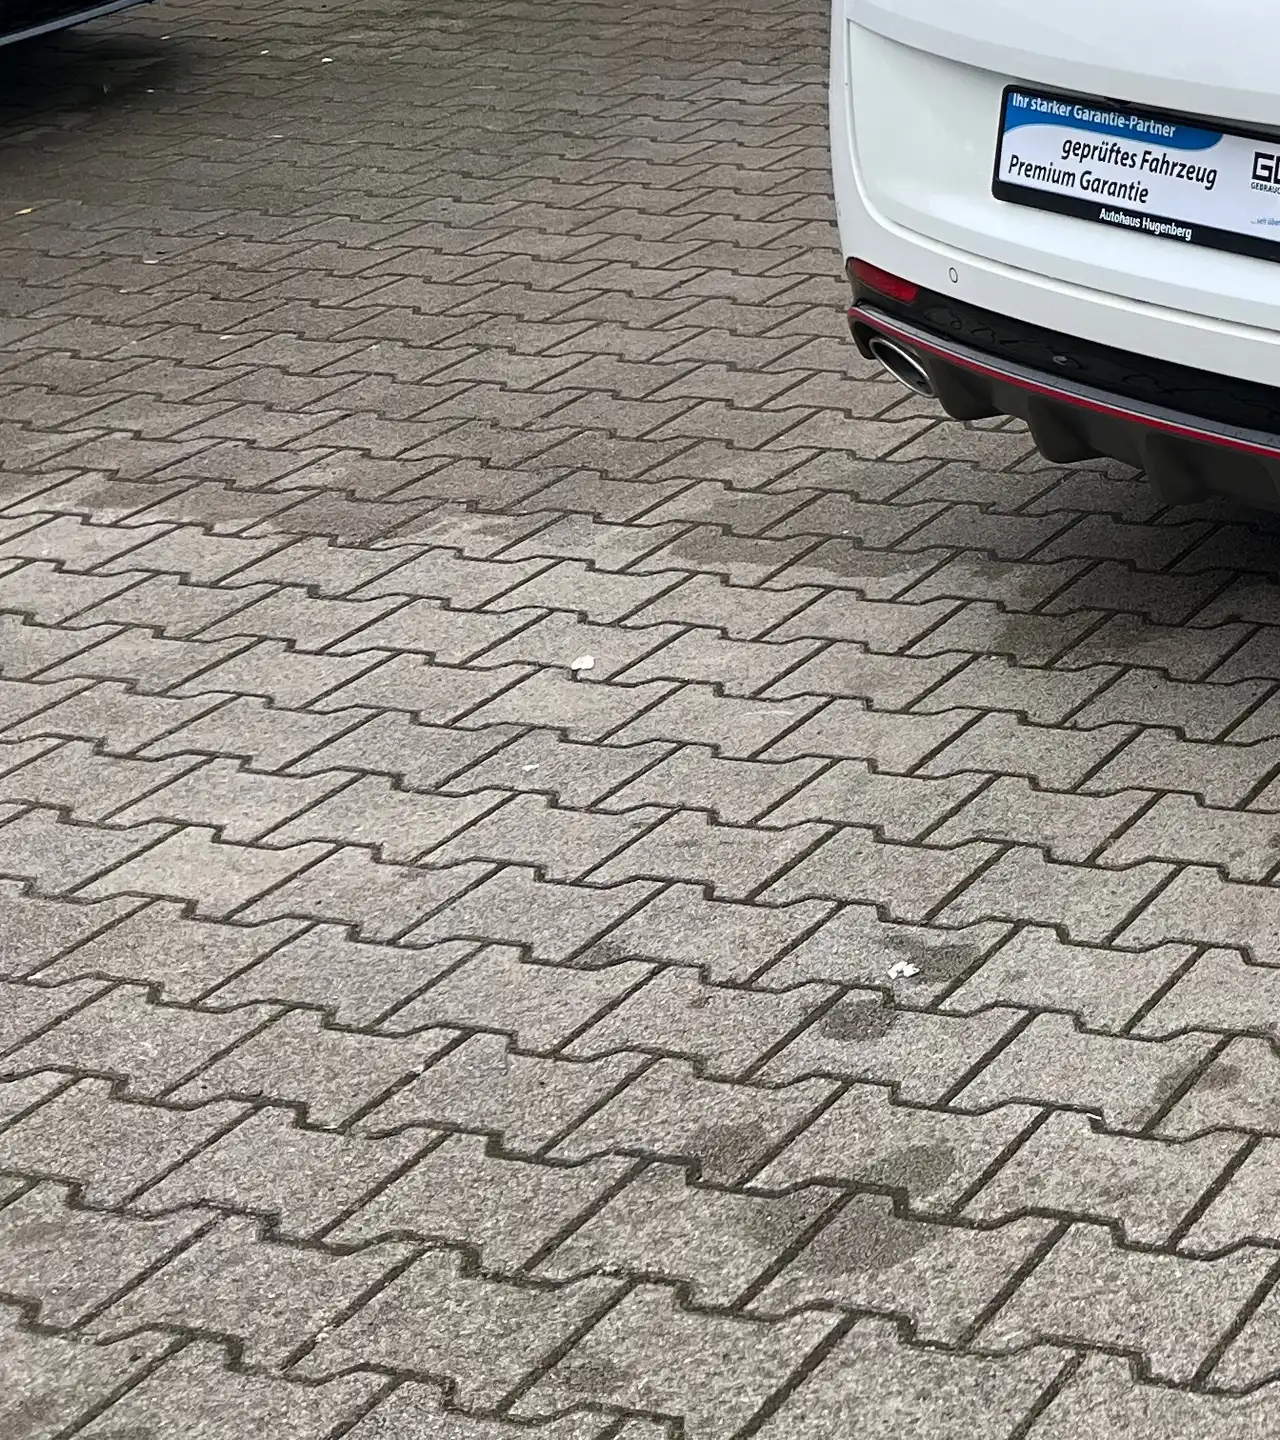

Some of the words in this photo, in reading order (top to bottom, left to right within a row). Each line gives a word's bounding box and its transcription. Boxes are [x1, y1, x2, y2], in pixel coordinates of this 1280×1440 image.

[1012, 93, 1028, 109] Ihr
[1030, 100, 1072, 117] starker
[1073, 108, 1177, 139] Garantie-Partner
[1008, 154, 1076, 188] Premium
[1080, 170, 1149, 203] Garantie
[1062, 138, 1137, 169] geprüftes
[1141, 151, 1218, 191] Fahrzeug
[1099, 208, 1141, 229] Autohaus
[1142, 216, 1192, 241] Hugenberg
